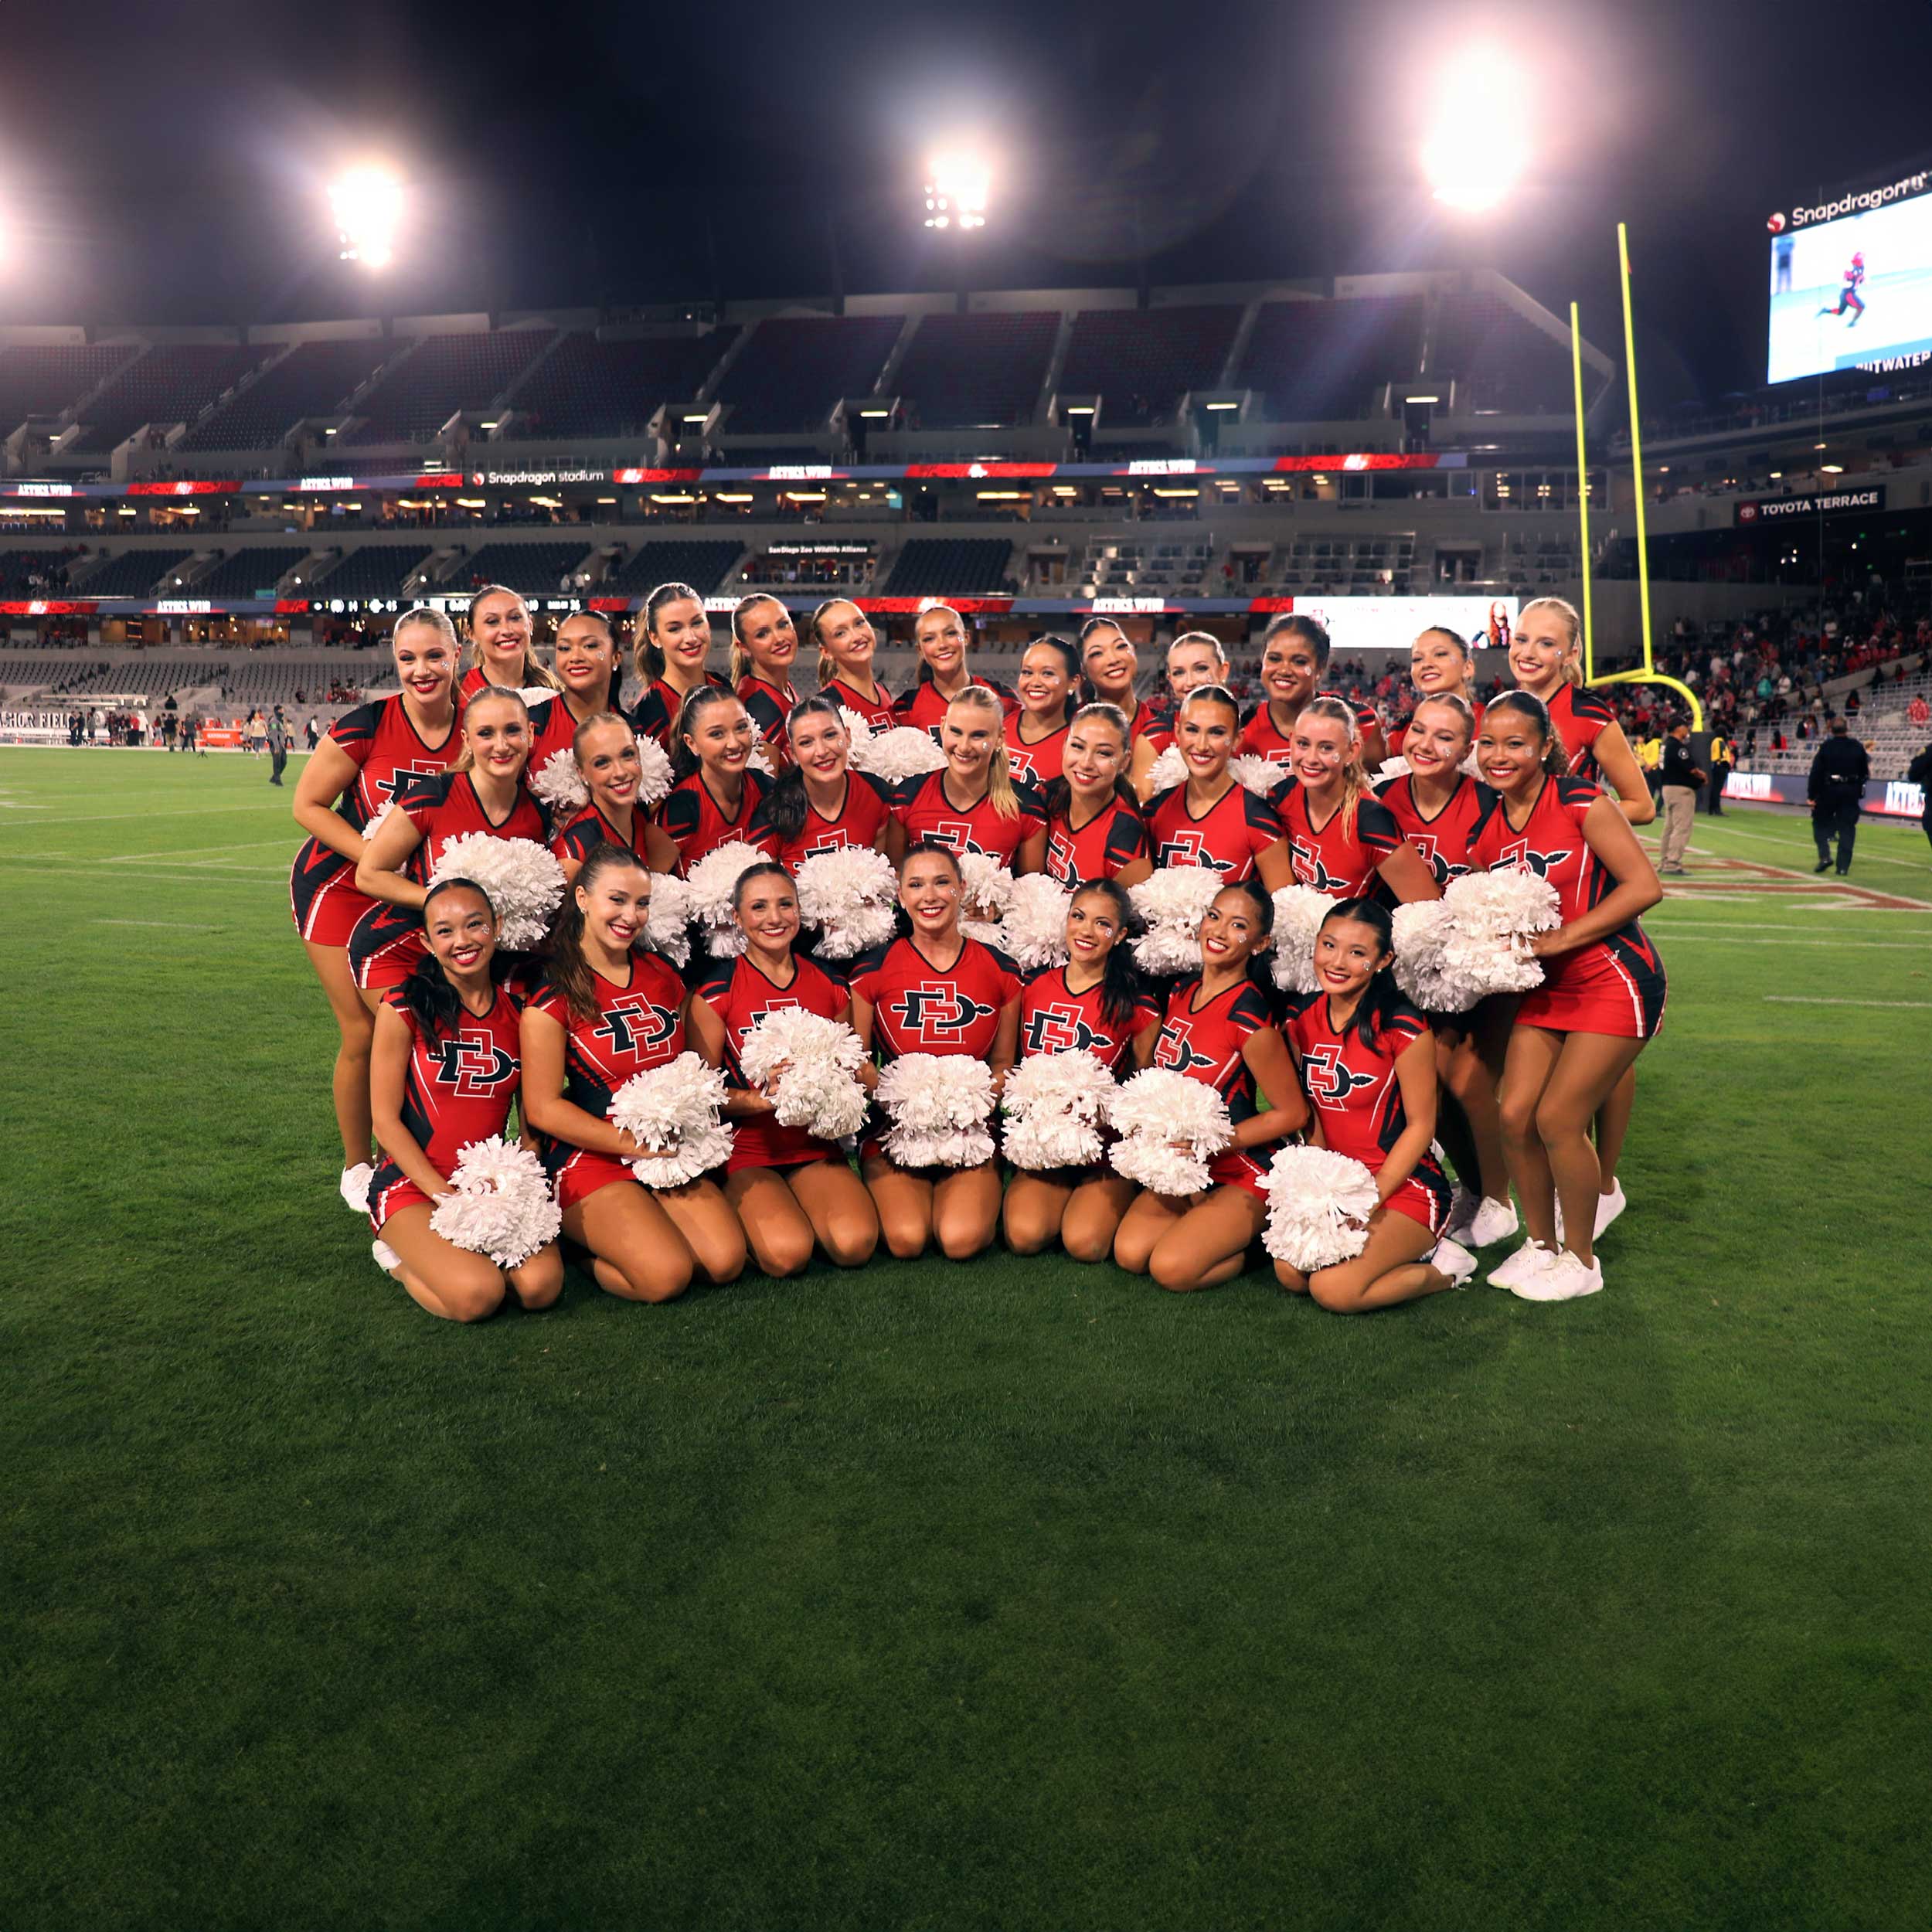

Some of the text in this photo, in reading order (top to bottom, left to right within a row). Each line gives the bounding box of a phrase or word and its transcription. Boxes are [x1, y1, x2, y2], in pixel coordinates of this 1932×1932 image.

[488, 470, 604, 486] Snapdragon stadium
[1761, 492, 1879, 516] TOYOTA TERRACE
[768, 546, 781, 554] San
[781, 546, 799, 555] Diego
